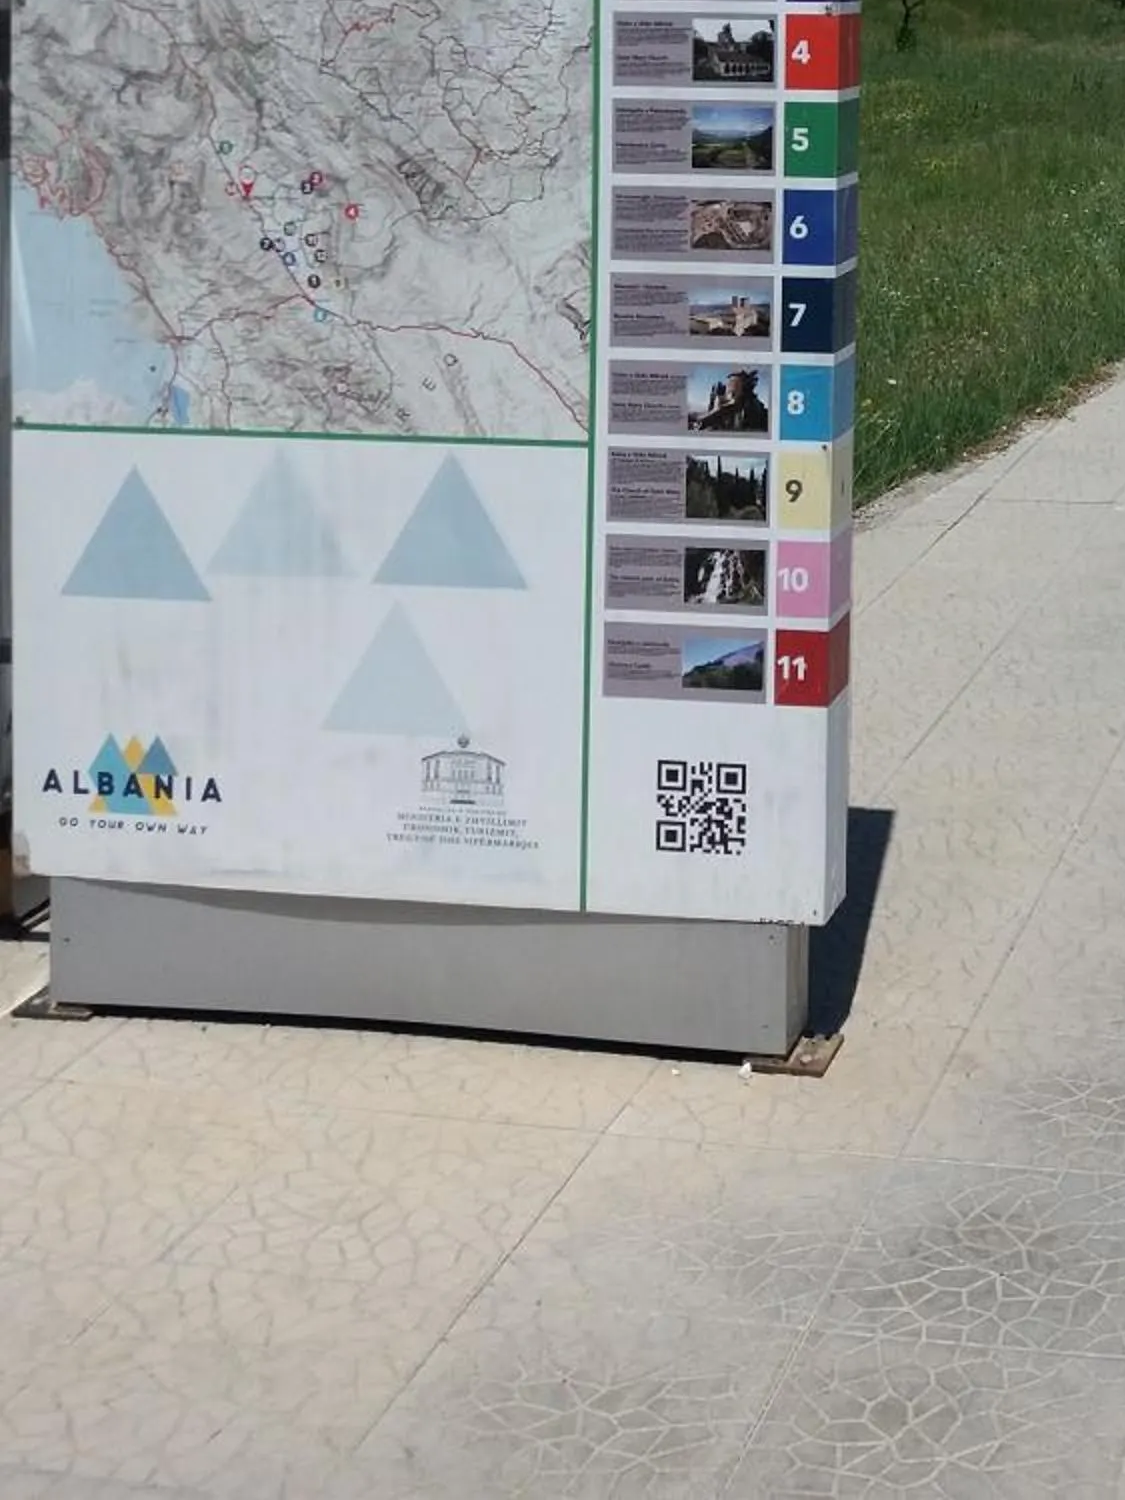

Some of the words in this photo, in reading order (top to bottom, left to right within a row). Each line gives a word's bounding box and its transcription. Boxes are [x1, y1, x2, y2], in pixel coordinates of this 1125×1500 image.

[791, 40, 811, 64] 4
[791, 127, 809, 152] 5
[789, 215, 808, 239] 6
[788, 303, 807, 327] 7
[787, 390, 805, 415] 8
[785, 479, 803, 503] 9
[777, 567, 809, 593] 10
[776, 655, 807, 681] 11
[42, 768, 222, 803] ALBANIA
[58, 817, 79, 827] GO
[88, 819, 125, 830] YOUR
[135, 821, 167, 833] OWN
[176, 824, 208, 835] WAY
